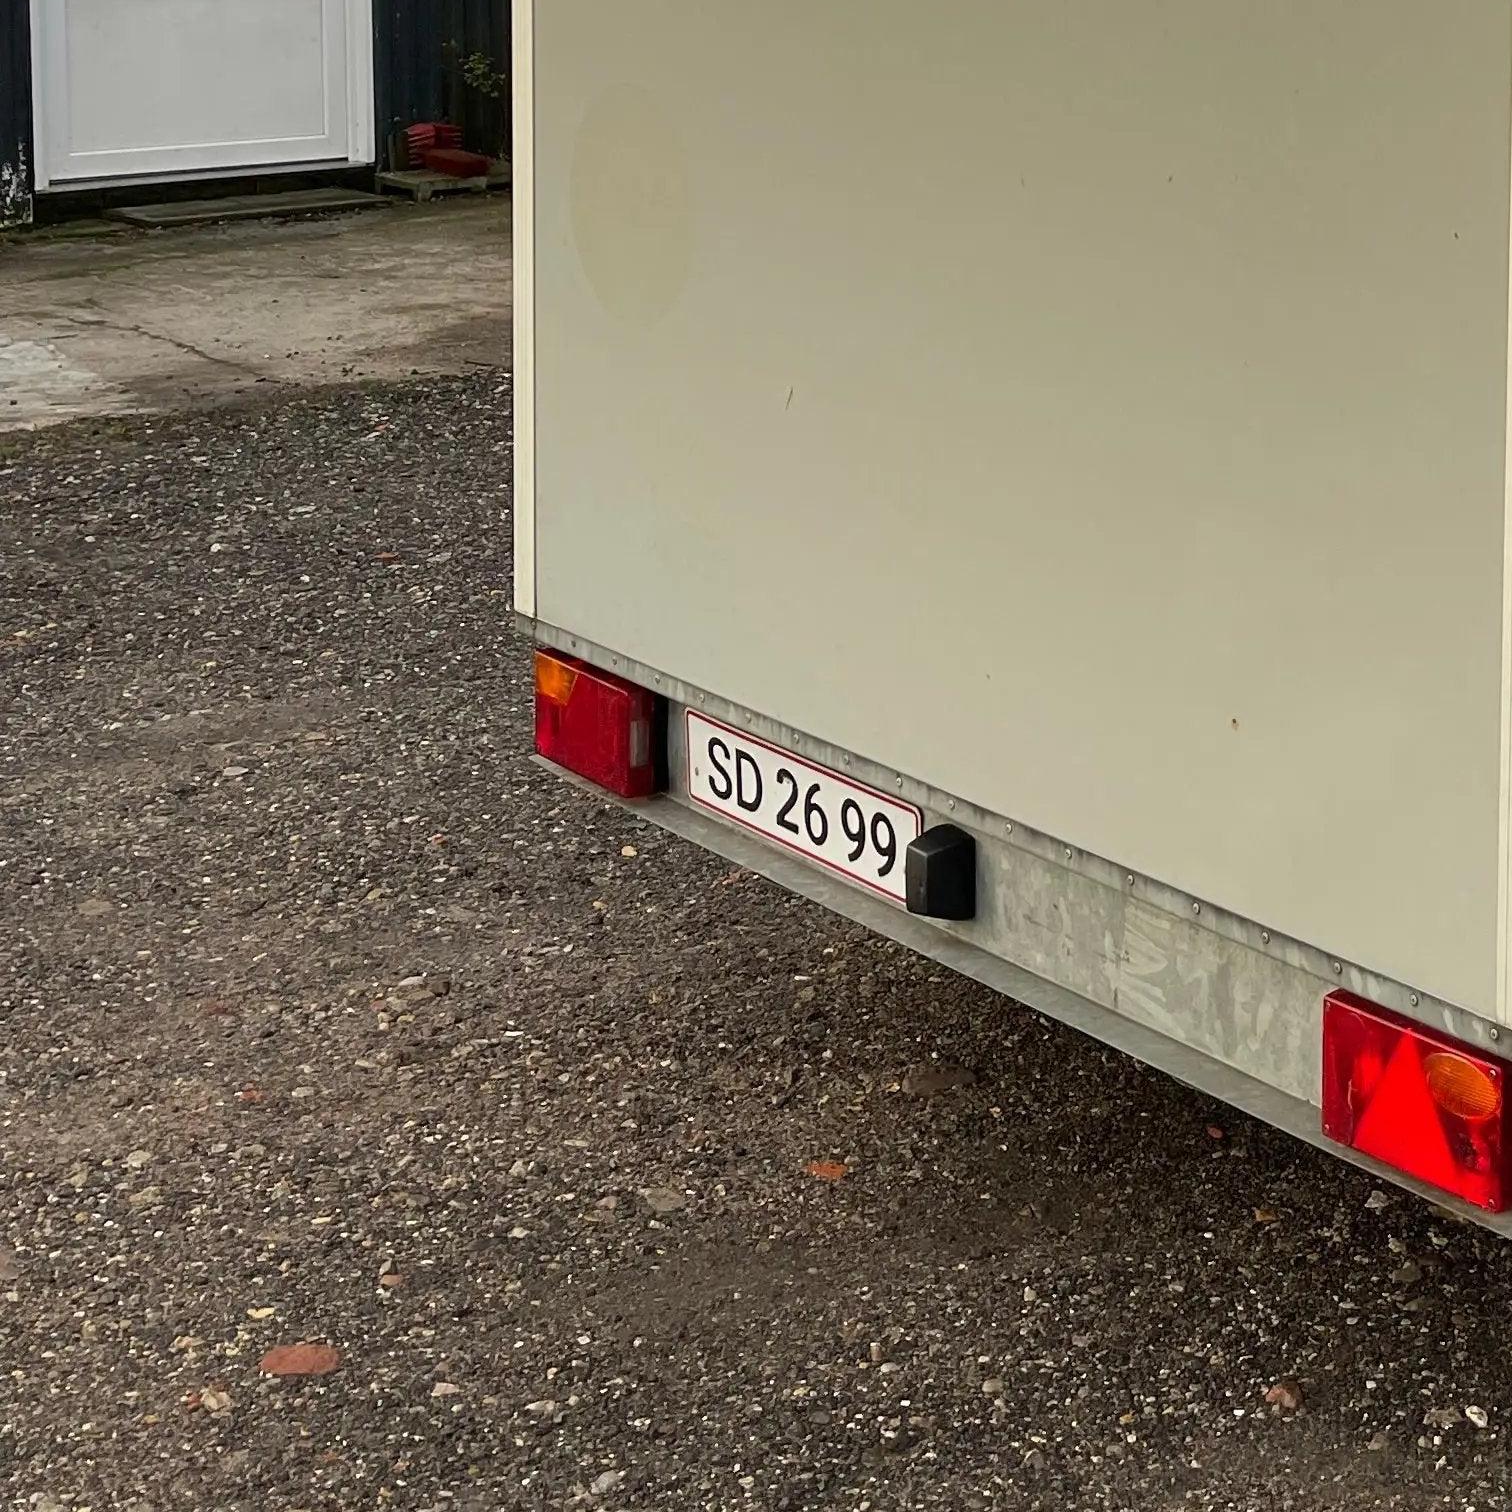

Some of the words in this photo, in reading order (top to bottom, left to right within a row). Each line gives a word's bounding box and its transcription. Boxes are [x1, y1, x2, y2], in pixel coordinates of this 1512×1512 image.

[708, 736, 763, 813] SD
[776, 768, 829, 847] 26
[841, 798, 897, 878] 99
